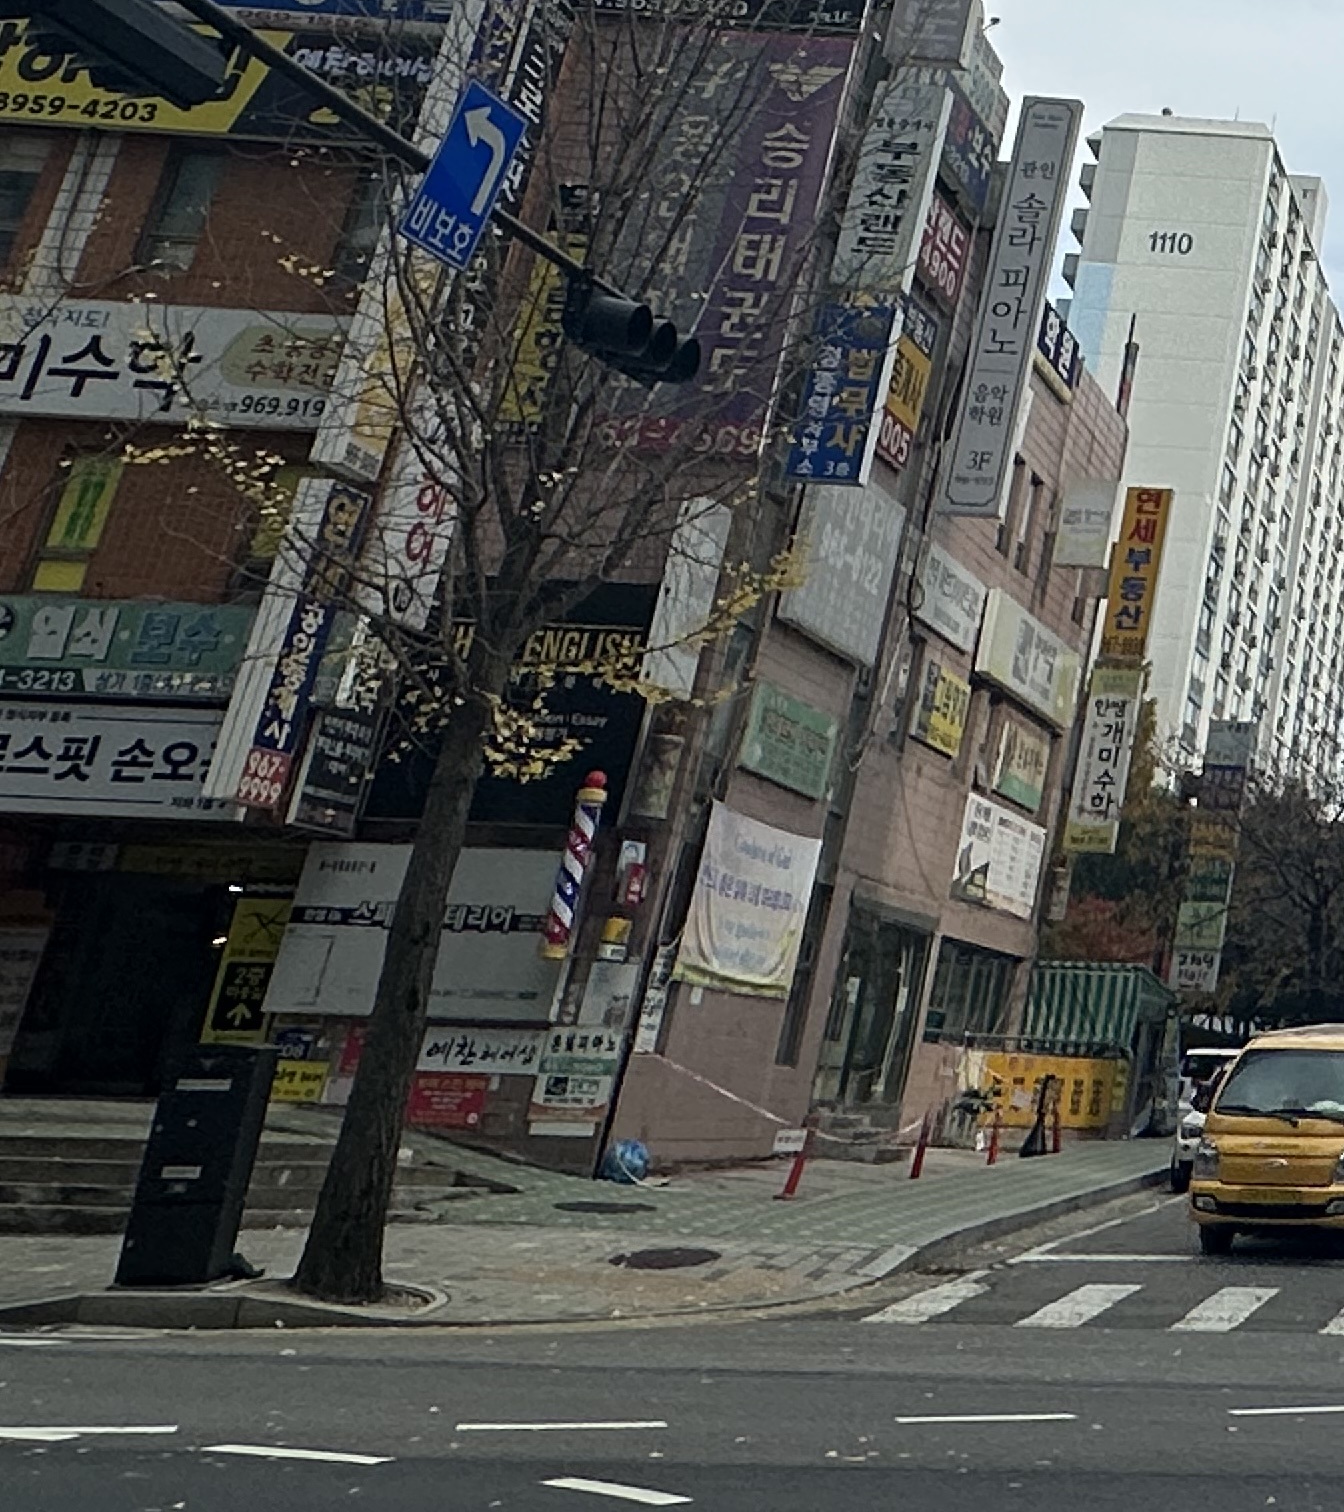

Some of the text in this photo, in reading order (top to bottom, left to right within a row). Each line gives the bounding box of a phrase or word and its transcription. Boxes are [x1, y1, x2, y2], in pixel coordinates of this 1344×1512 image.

[410, 193, 474, 260] 비보호
[1012, 193, 1049, 257] 솔라
[1148, 230, 1194, 255] 1110
[984, 264, 1031, 356] 피아노
[964, 450, 994, 471] 3F
[1131, 489, 1162, 544] 연세
[1114, 546, 1152, 630] 부동산
[0, 734, 215, 784] 스핏 손오
